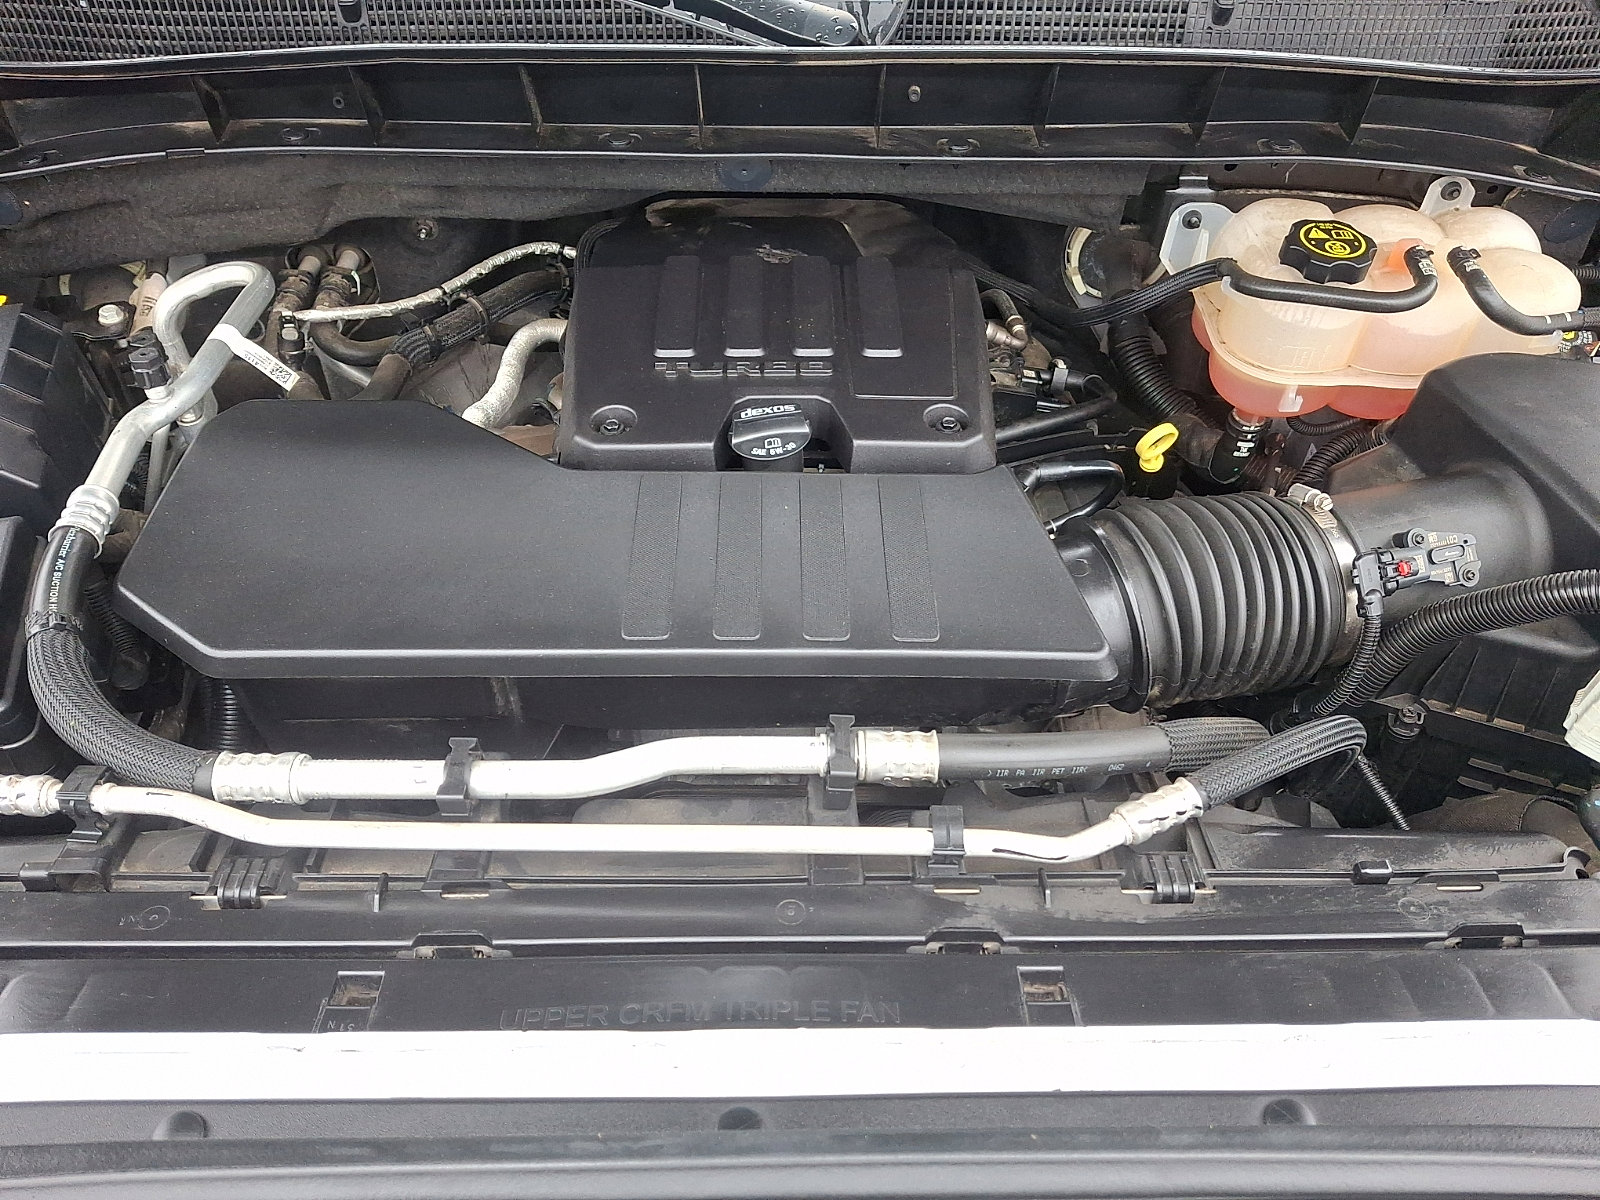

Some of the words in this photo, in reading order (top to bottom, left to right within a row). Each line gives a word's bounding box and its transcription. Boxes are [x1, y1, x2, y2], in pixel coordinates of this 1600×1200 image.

[654, 361, 833, 378] TURBO
[740, 404, 797, 419] dexos
[751, 447, 767, 456] SAE
[49, 572, 62, 602] SUCTION
[1051, 767, 1066, 775] PET
[499, 1004, 609, 1031] UPPER
[839, 999, 902, 1023] FAN
